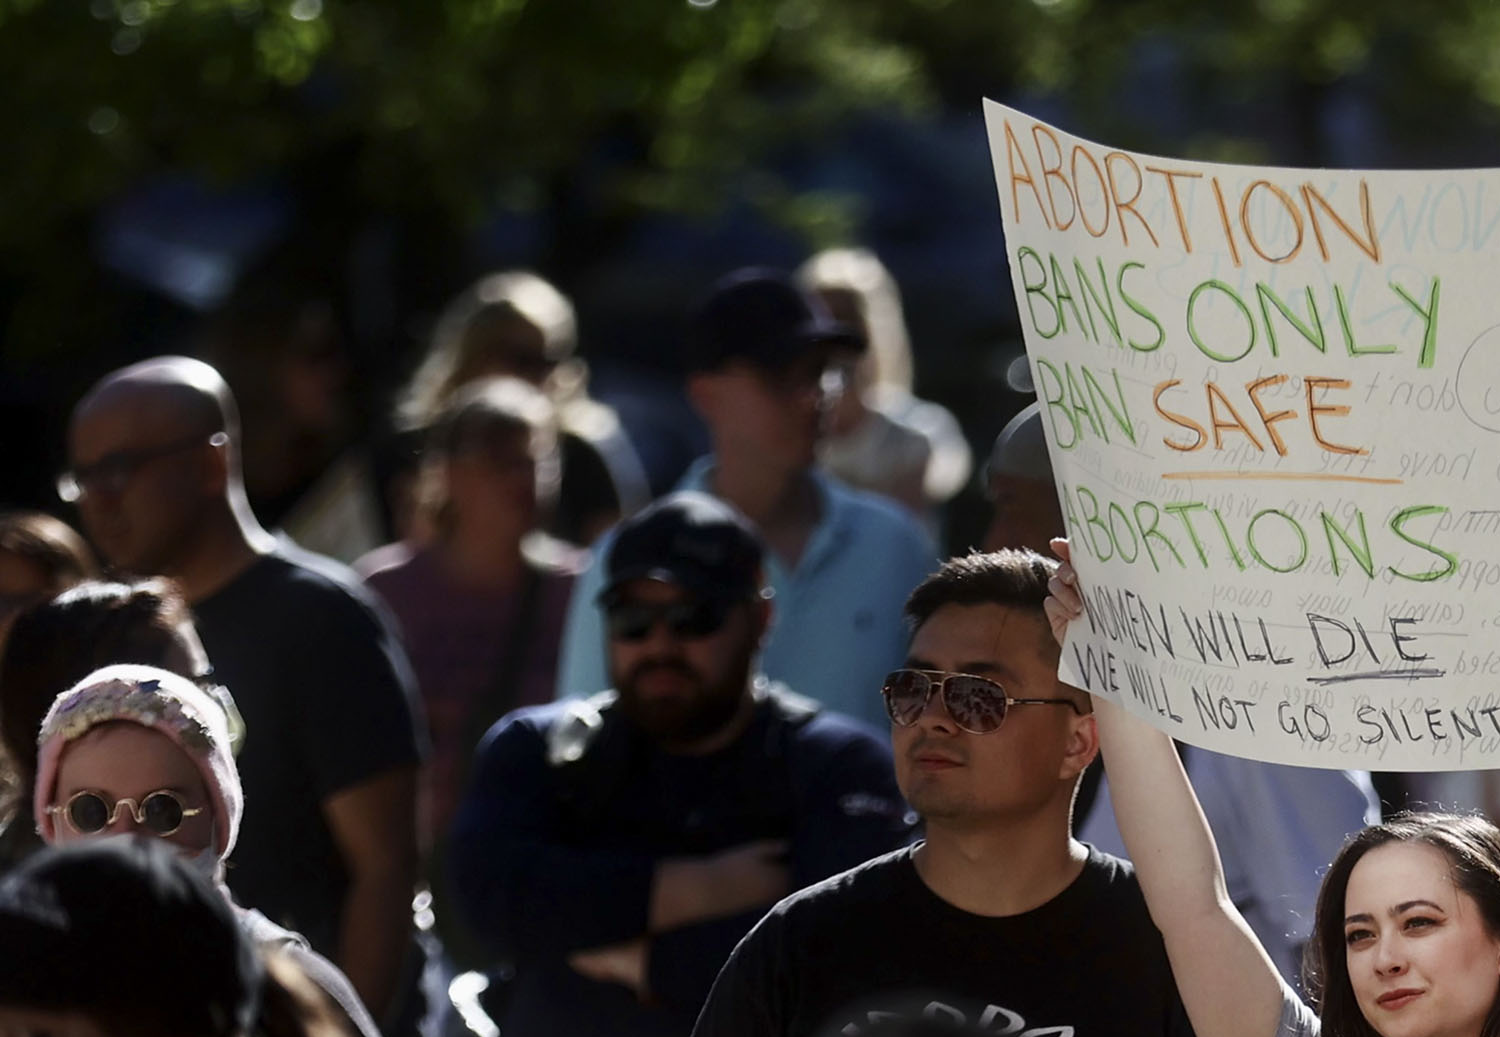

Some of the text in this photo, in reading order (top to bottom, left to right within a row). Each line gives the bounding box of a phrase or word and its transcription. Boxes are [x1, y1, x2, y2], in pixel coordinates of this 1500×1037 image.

[1003, 119, 1382, 266] ABORTION
[1018, 246, 1440, 368] BANS ONLY
[1036, 357, 1136, 449] BAN
[1153, 373, 1370, 456] SAFE
[1066, 485, 1460, 582] ABORTIONS
[1183, 607, 1294, 666] WILL
[1308, 612, 1430, 666] DIE
[1073, 641, 1121, 693] WE
[1123, 659, 1184, 725] WILL
[1190, 685, 1258, 735] NOT
[1278, 697, 1331, 745] GO
